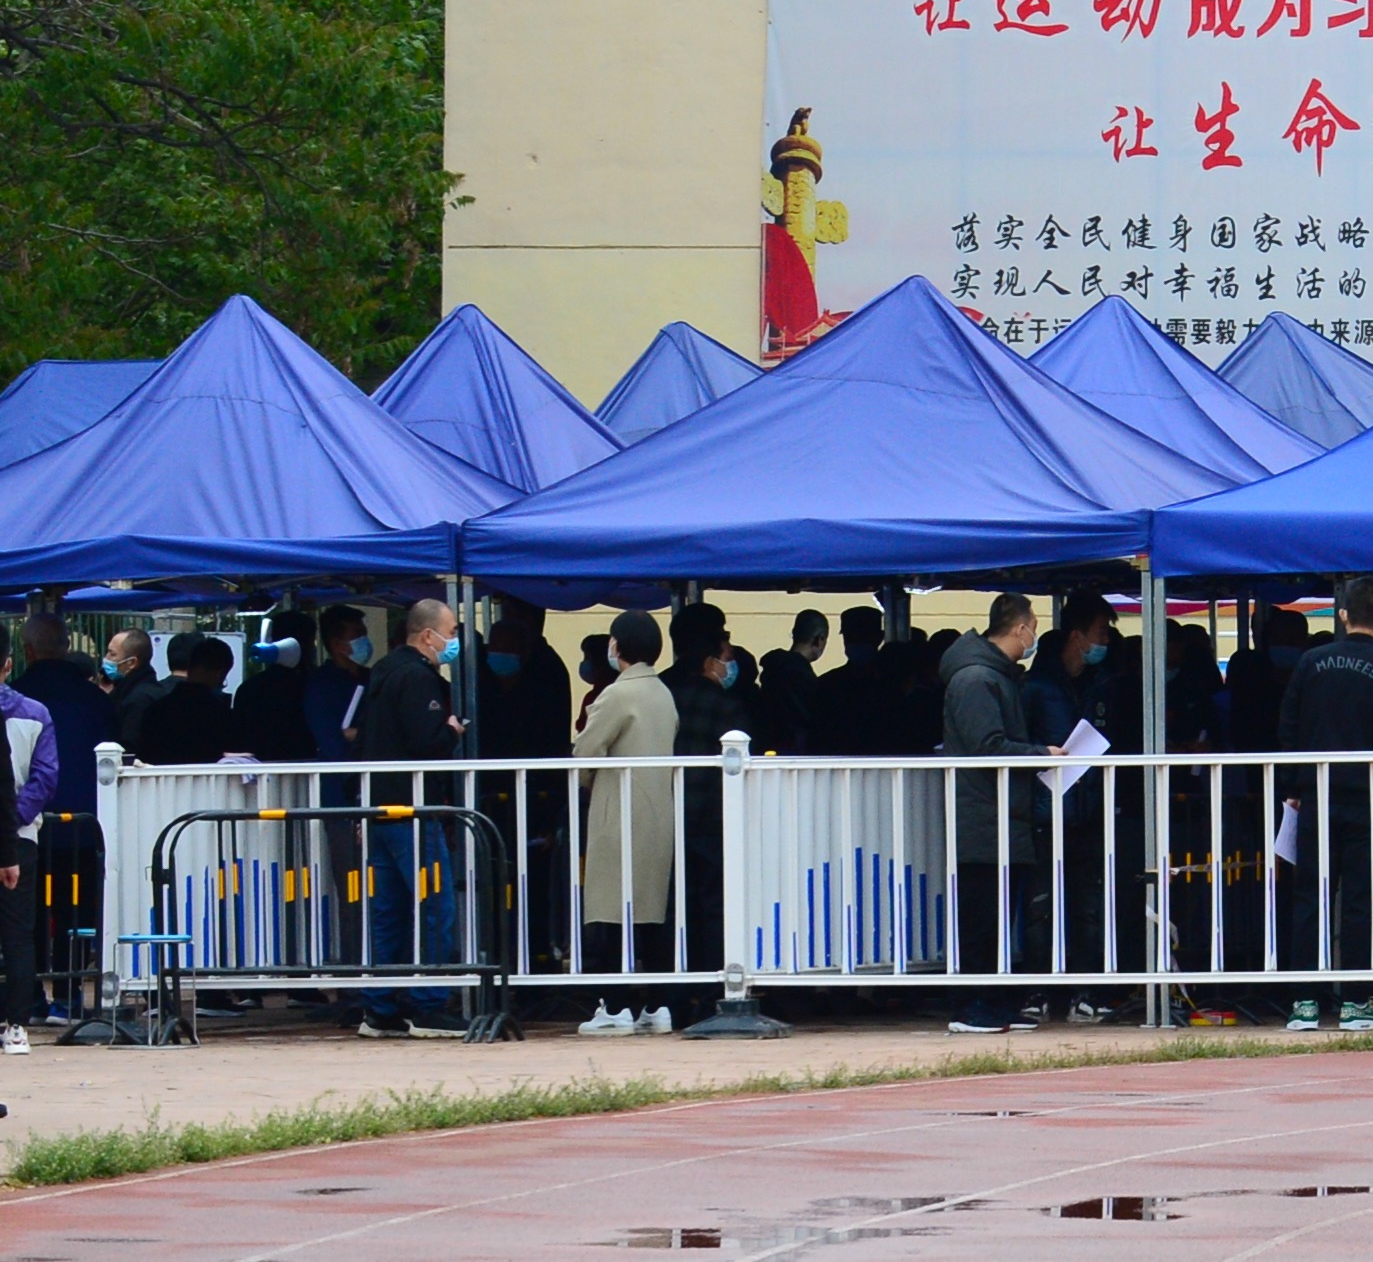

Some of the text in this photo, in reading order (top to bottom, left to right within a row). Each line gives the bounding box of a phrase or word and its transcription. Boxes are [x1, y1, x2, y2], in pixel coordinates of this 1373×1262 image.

[951, 213, 1370, 252] 落实全民健身国家战略
